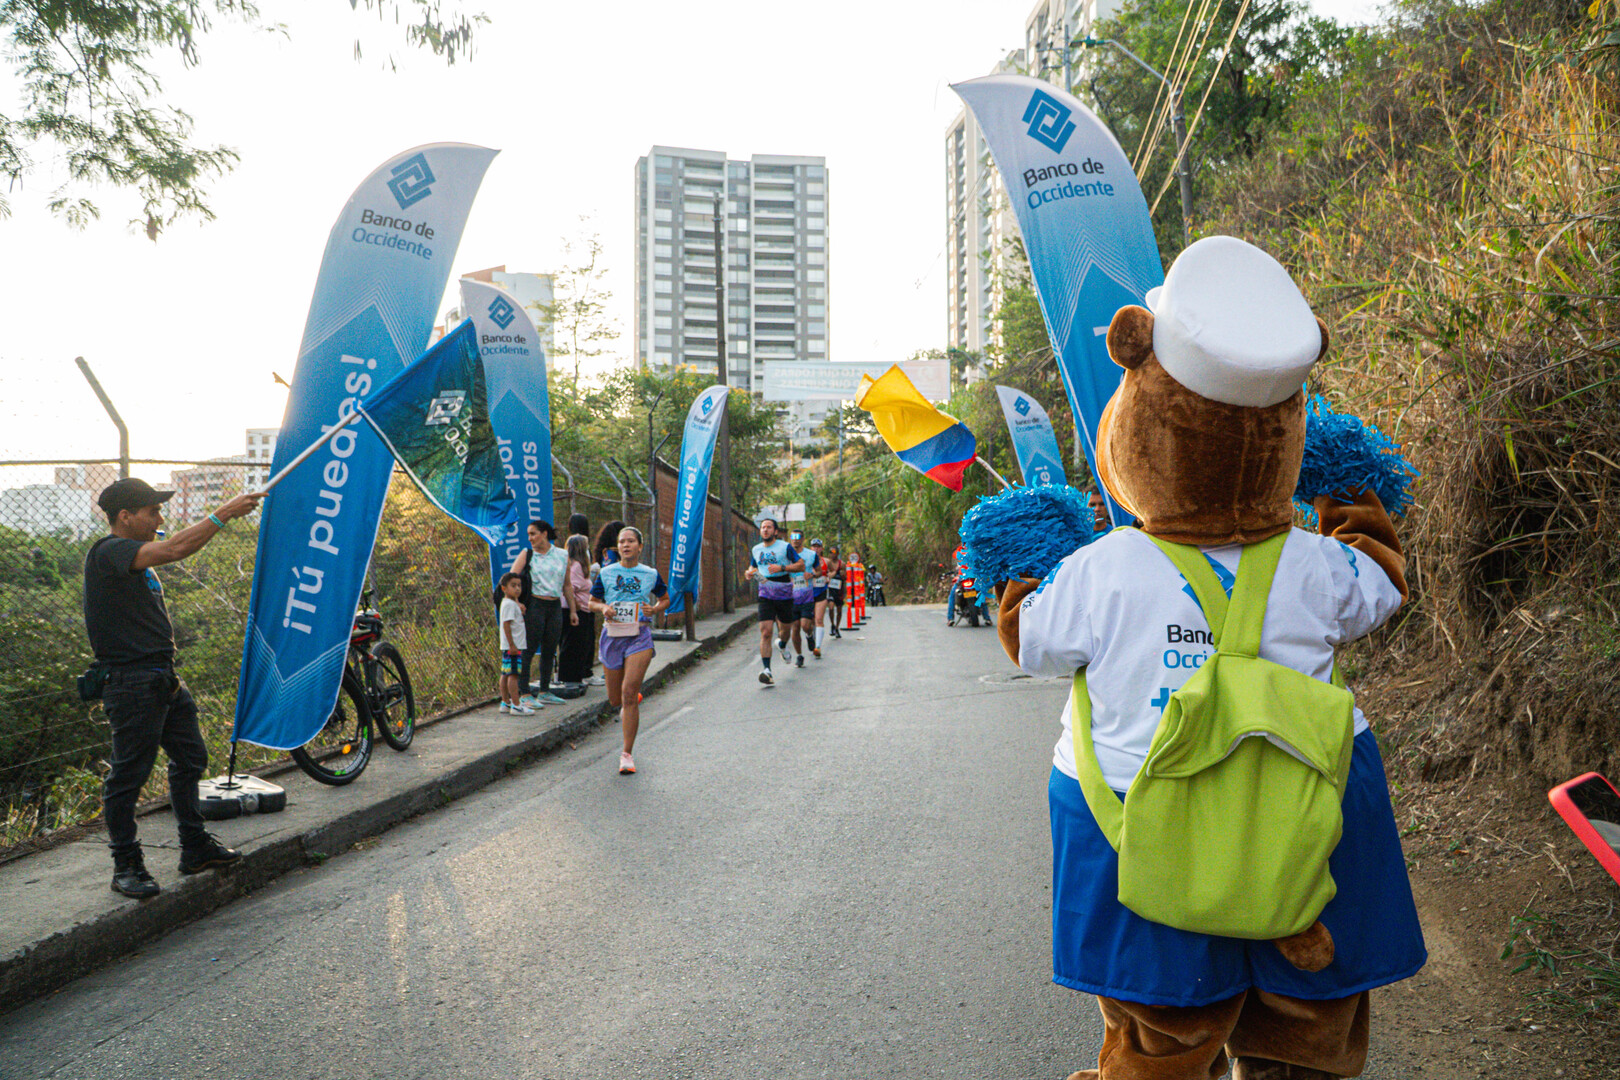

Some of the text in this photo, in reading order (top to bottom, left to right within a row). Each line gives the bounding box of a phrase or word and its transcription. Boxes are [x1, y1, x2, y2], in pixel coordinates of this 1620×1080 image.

[1023, 158, 1104, 188] Banco de
[1027, 180, 1114, 210] Occidente
[360, 208, 435, 240] Banco de
[351, 227, 433, 260] Occidente
[481, 345, 529, 356] Occidente
[482, 334, 526, 344] Banco de
[283, 354, 377, 635] ¡Tú puedes!
[522, 441, 542, 521] metas
[671, 466, 698, 579] ¡Eres fuerte!
[1167, 624, 1215, 645] Banc
